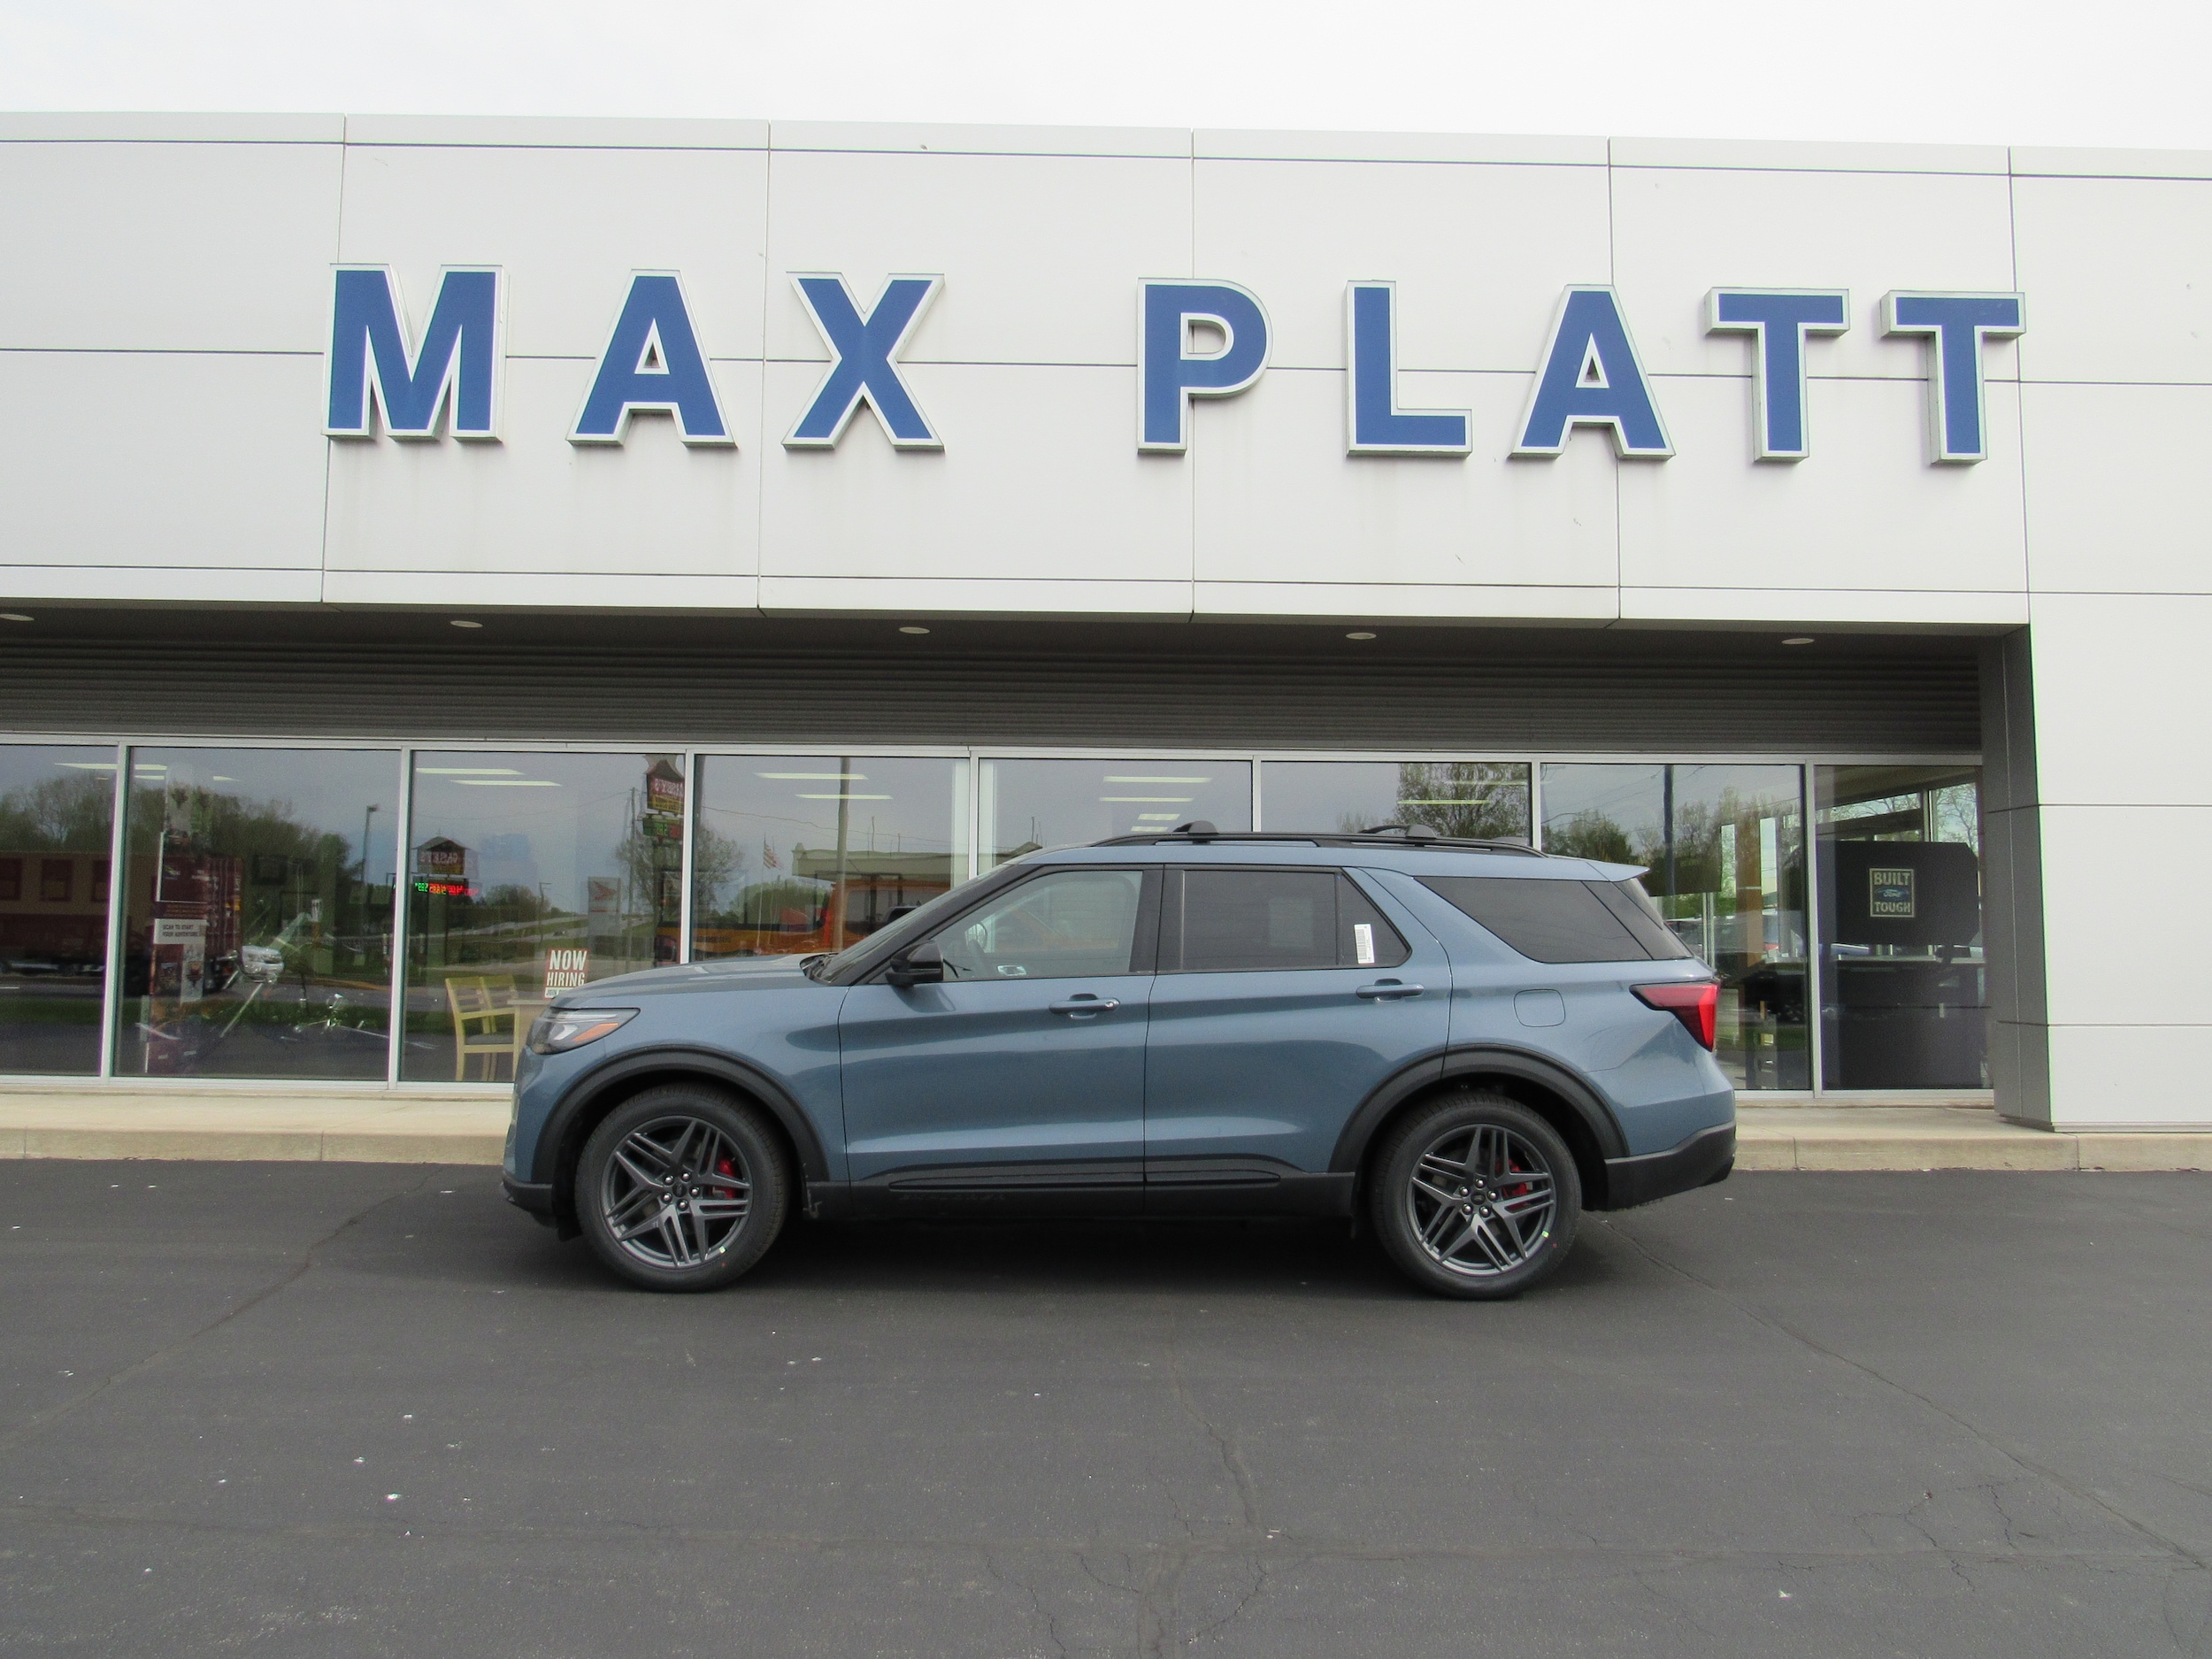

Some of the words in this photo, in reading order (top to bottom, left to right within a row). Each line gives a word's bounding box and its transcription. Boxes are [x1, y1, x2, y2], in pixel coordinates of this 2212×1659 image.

[321, 263, 945, 449] MAX
[1137, 277, 2026, 465] PLATT
[1874, 872, 1910, 885] BUILT
[1875, 902, 1911, 912] TOUGH
[549, 949, 588, 971] NOW
[547, 972, 585, 987] HIRING
